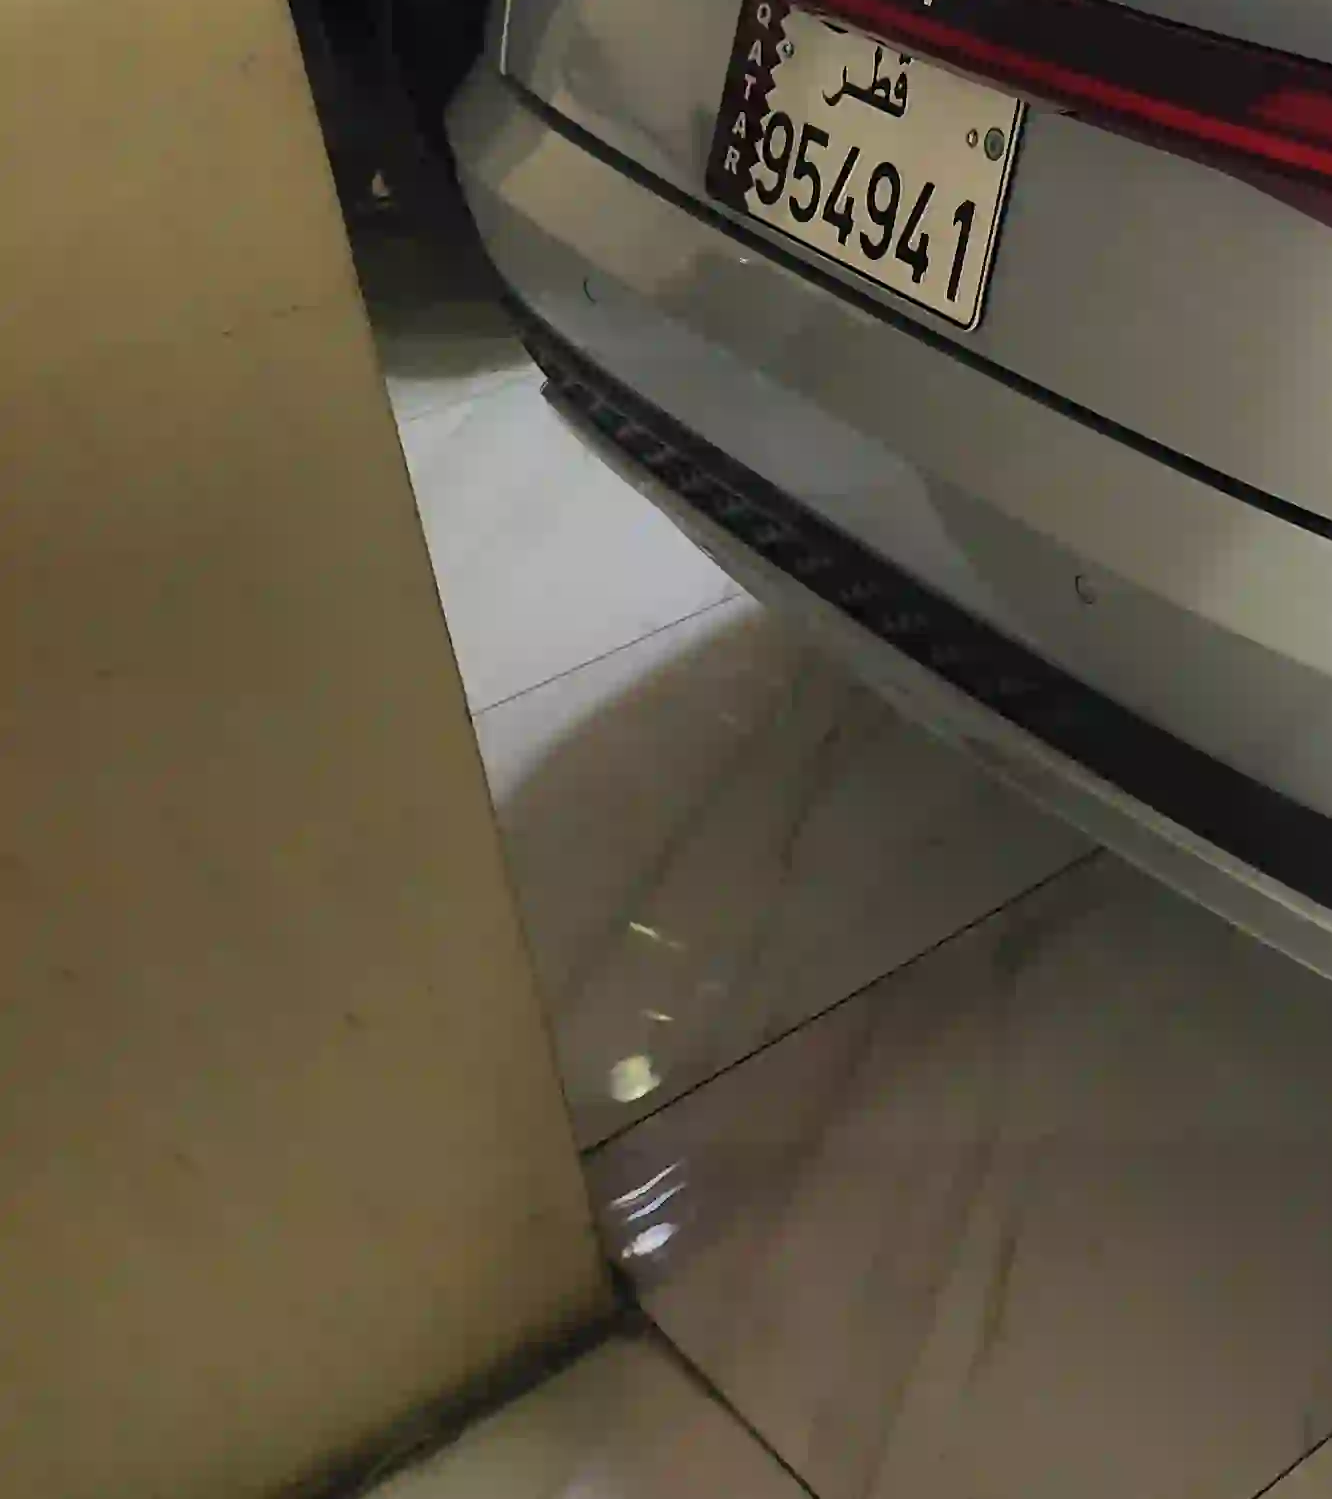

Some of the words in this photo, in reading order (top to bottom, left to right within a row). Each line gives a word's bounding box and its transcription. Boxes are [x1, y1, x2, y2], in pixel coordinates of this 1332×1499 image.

[724, 2, 773, 175] QATAR
[821, 44, 915, 118] قطر
[752, 110, 977, 302] 954941
